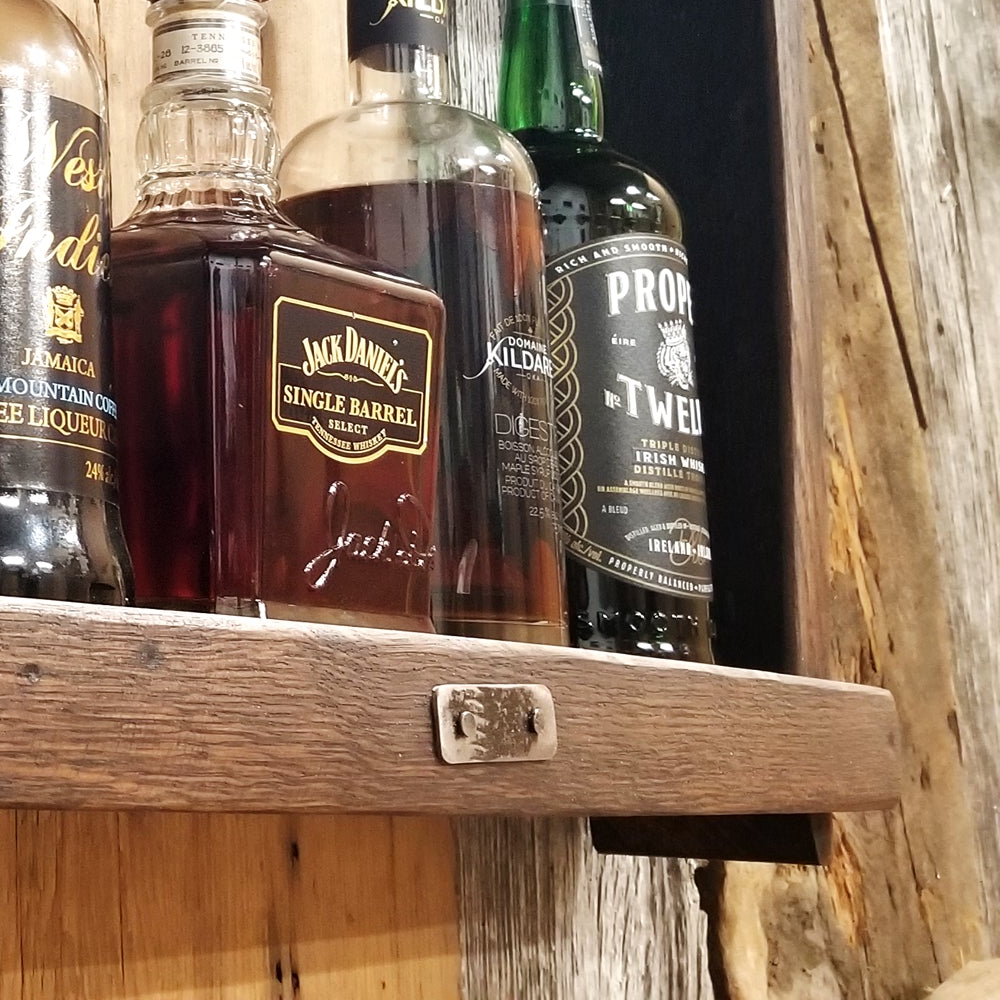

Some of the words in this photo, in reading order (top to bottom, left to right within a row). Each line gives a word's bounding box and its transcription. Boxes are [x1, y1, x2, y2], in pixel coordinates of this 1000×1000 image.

[555, 256, 588, 274] RICH
[593, 246, 619, 259] AND
[624, 243, 668, 253] SMOOTH
[508, 336, 547, 354] DOMAINE
[611, 333, 636, 347] ÉIRE
[21, 348, 96, 378] JAMAICA
[302, 334, 345, 376] JACK
[345, 326, 408, 394] DANIEL'S
[463, 335, 553, 379] KILDARE
[493, 367, 512, 389] MADE
[283, 384, 345, 414] SINGLE
[349, 397, 417, 427] BARREL
[27, 404, 106, 441] LIQUEUR
[311, 416, 351, 450] TENNESSEE
[353, 428, 387, 451] WHISKEY
[328, 418, 368, 435] SELECT
[636, 450, 677, 466] IRISH
[641, 438, 680, 452] TRIPLE
[601, 505, 607, 513] A
[608, 556, 654, 581] PROPERLY
[657, 574, 695, 592] BALANCED
